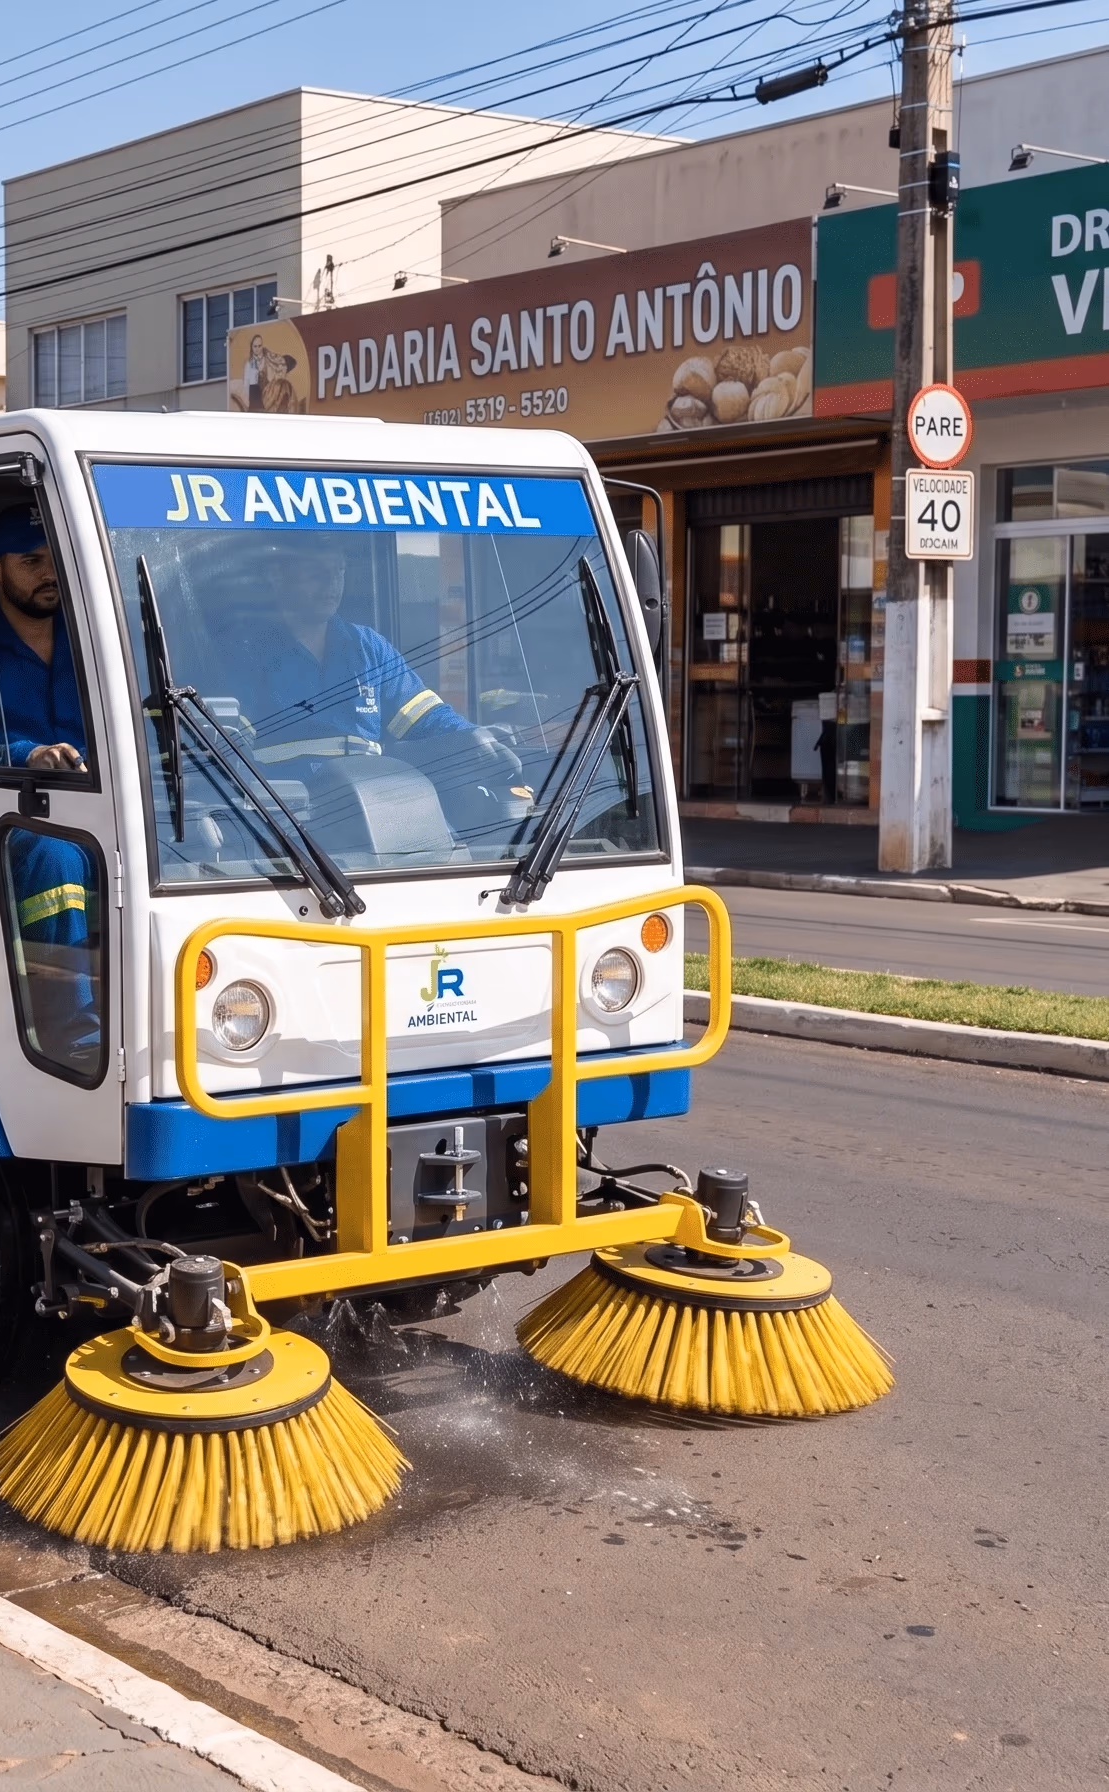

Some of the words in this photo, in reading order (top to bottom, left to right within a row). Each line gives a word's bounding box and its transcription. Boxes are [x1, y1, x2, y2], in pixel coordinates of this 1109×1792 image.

[317, 323, 461, 399] PADARIA
[470, 299, 595, 376] SANTO
[605, 261, 803, 357] ANTÔNIO
[466, 395, 506, 423] 5319
[520, 387, 568, 416] 5520
[915, 416, 963, 436] PARE
[166, 474, 231, 522] JR
[244, 476, 542, 528] AMBIENTAL
[913, 478, 968, 495] VELOCIDADE
[917, 500, 961, 532] 40
[420, 960, 464, 1001] JR
[408, 1010, 478, 1028] AMBIENTAL
